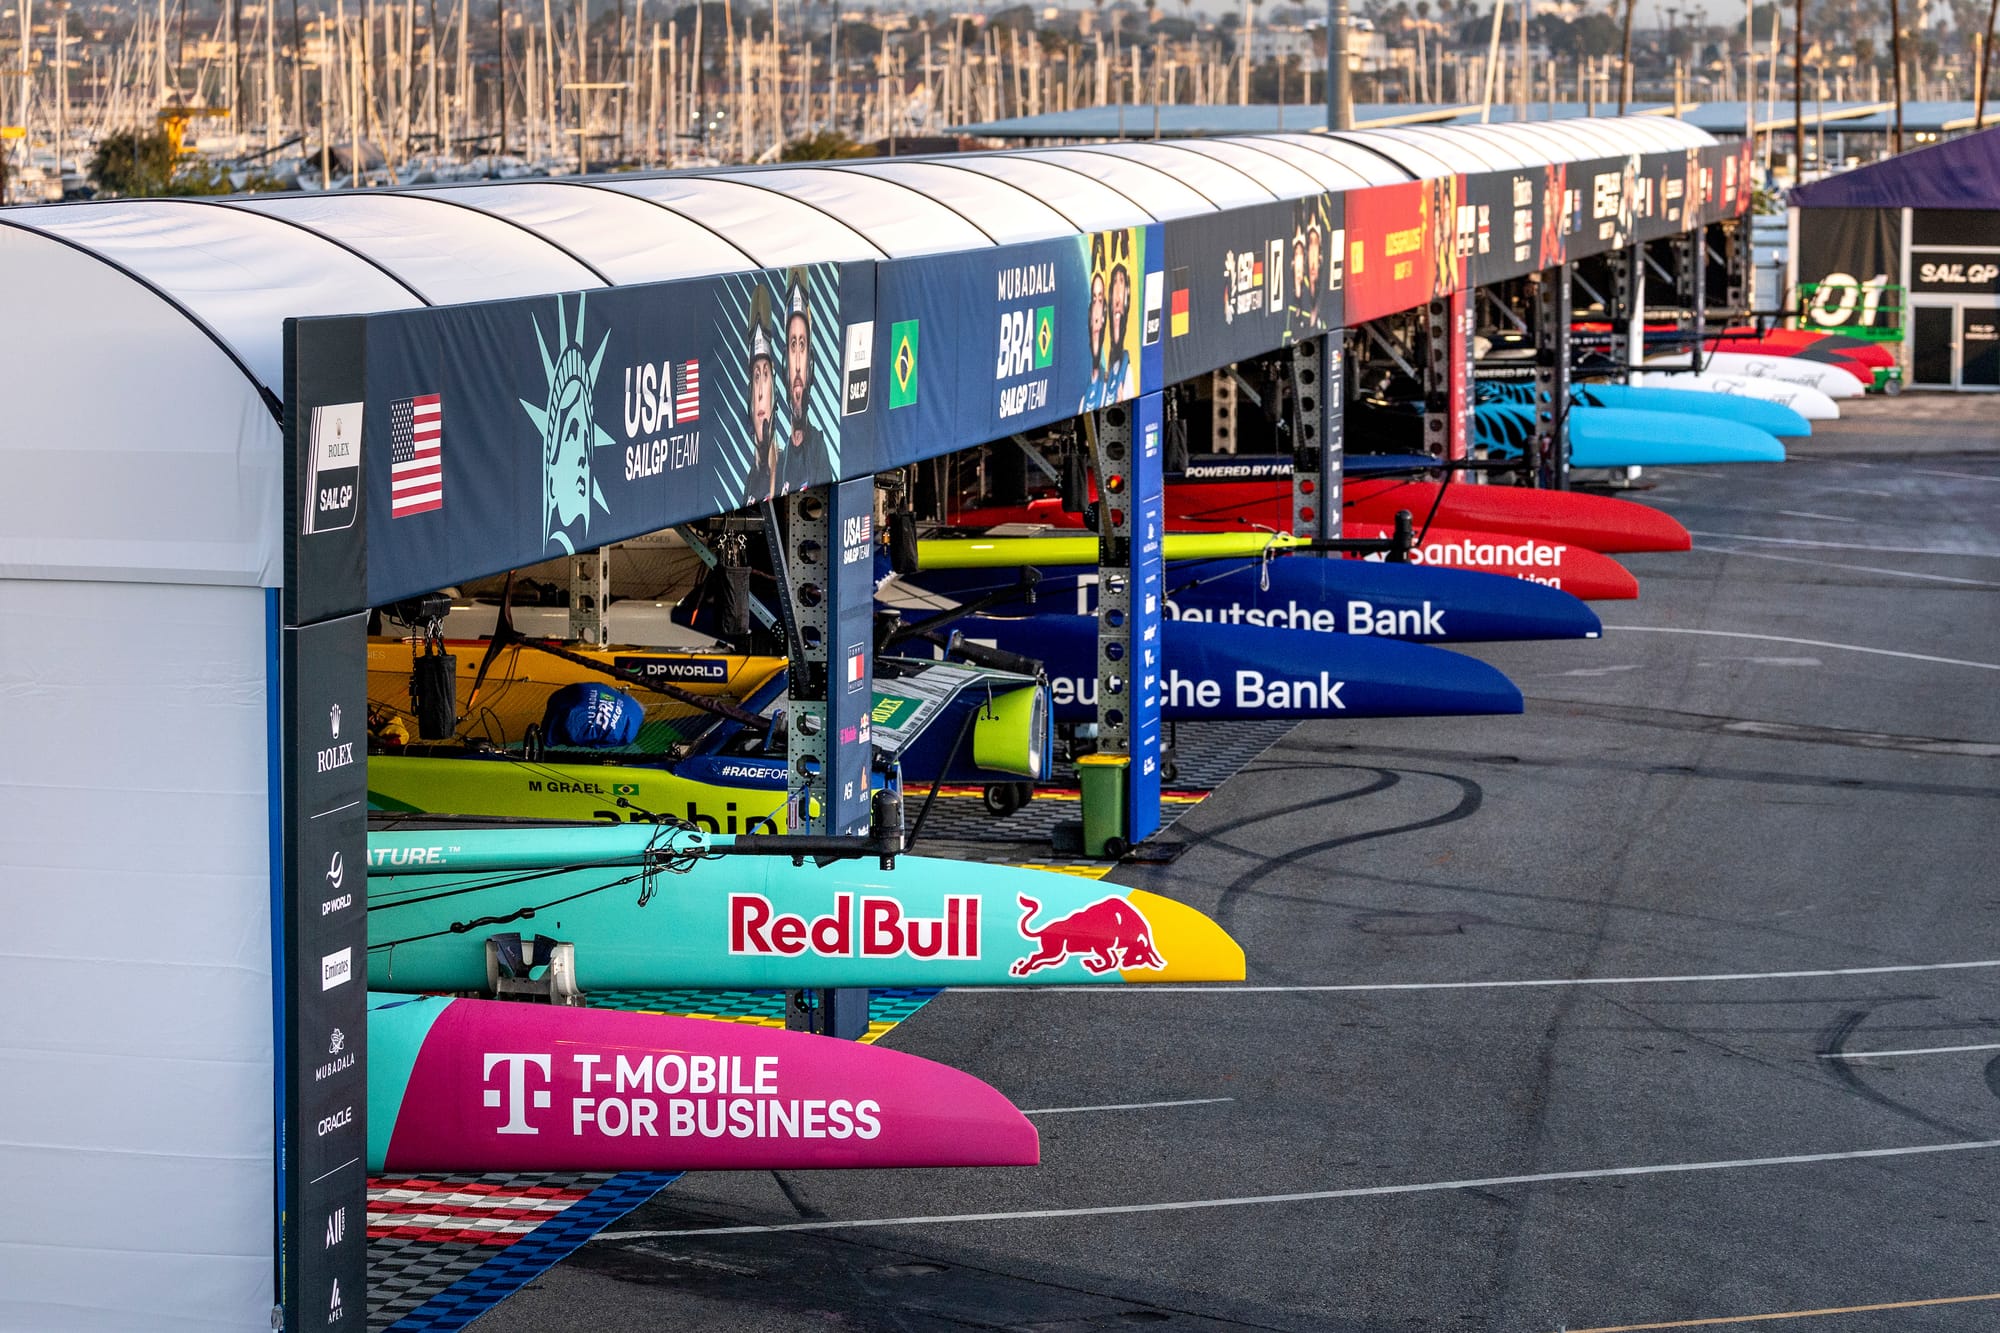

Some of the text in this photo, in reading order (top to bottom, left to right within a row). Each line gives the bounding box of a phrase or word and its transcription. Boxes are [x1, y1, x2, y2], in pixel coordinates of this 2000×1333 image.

[998, 262, 1056, 302] MUBADALA
[1810, 272, 1889, 327] 01
[996, 308, 1034, 380] BRA
[1474, 368, 1514, 378] OWERED
[624, 360, 674, 438] USA
[1028, 379, 1048, 411] TEAM
[328, 443, 350, 458] ROLEX
[625, 432, 700, 481] SAILGP TEAM
[1185, 466, 1250, 478] POWERED
[1252, 465, 1271, 476] BY
[844, 516, 861, 548] USA
[1348, 601, 1446, 635] Bank
[647, 665, 724, 676] DP WORLD
[1236, 670, 1345, 708] Bank
[317, 742, 354, 773] ROLEX
[529, 781, 604, 794] M GRAEL
[729, 892, 982, 960] Red Bull
[325, 958, 349, 982] Emirates
[316, 1052, 355, 1082] MUBADALA
[573, 1054, 779, 1094] T-MOBILE
[318, 1106, 352, 1137] ORACLE
[573, 1097, 881, 1140] FOR BUSINESS
[328, 1307, 343, 1325] APEX
